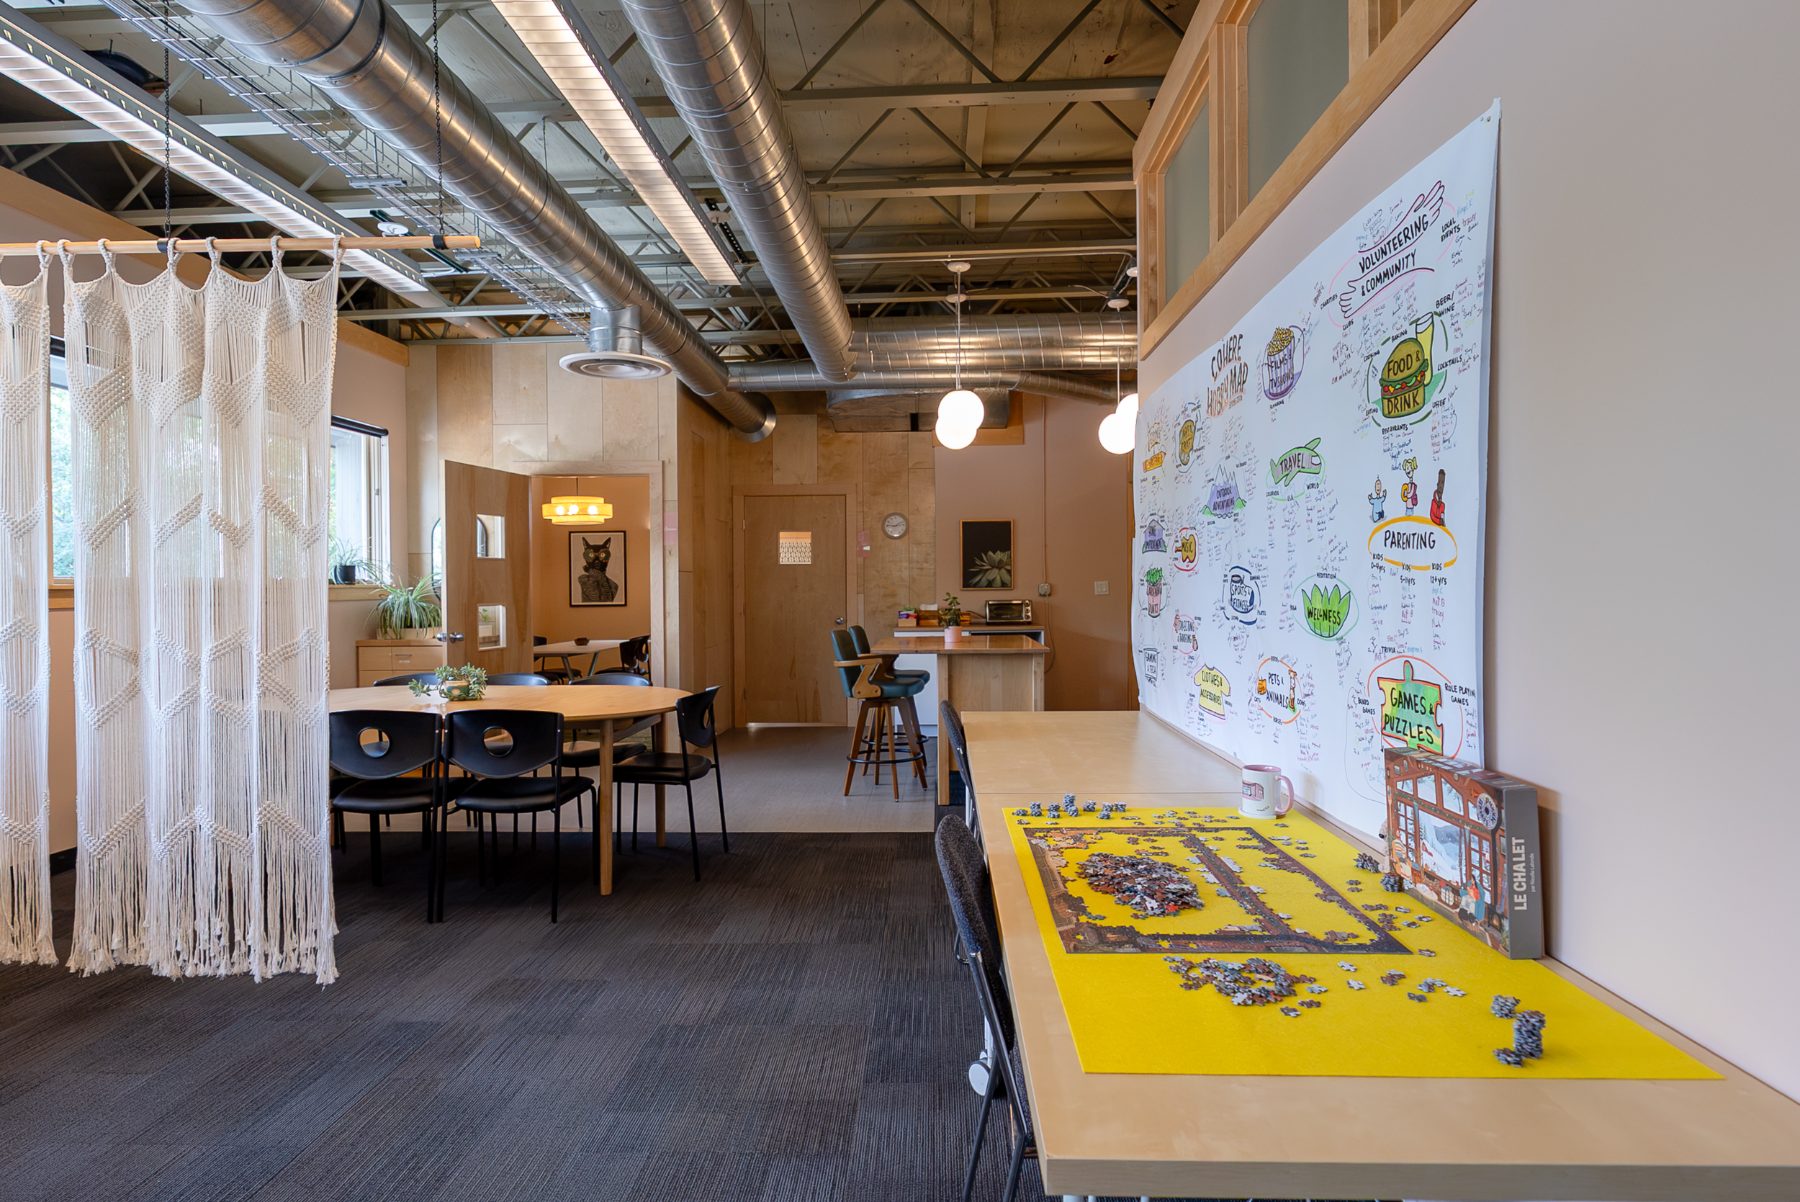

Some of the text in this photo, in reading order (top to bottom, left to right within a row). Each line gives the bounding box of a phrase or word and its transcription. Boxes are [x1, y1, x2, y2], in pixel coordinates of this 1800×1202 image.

[1441, 217, 1457, 233] LOCAL
[1358, 213, 1430, 274] VOLUNTEERING
[1211, 334, 1244, 382] COHERE
[1386, 350, 1421, 379] FOOD &
[1386, 390, 1420, 415] DRINK
[1280, 452, 1306, 475] TRAVEL
[1384, 529, 1436, 551] PARENTING
[1372, 553, 1384, 561] KIDS
[1431, 562, 1442, 571] KIDS
[1307, 605, 1341, 626] WELLNESS
[1268, 672, 1281, 686] PETS
[1444, 682, 1458, 693] ROLE
[1266, 690, 1289, 709] ANIMALS
[1389, 687, 1427, 715] GAMES
[1451, 695, 1469, 707] GAMES
[1383, 713, 1435, 745] PUZZLES
[1511, 836, 1528, 911] LE CHALET
